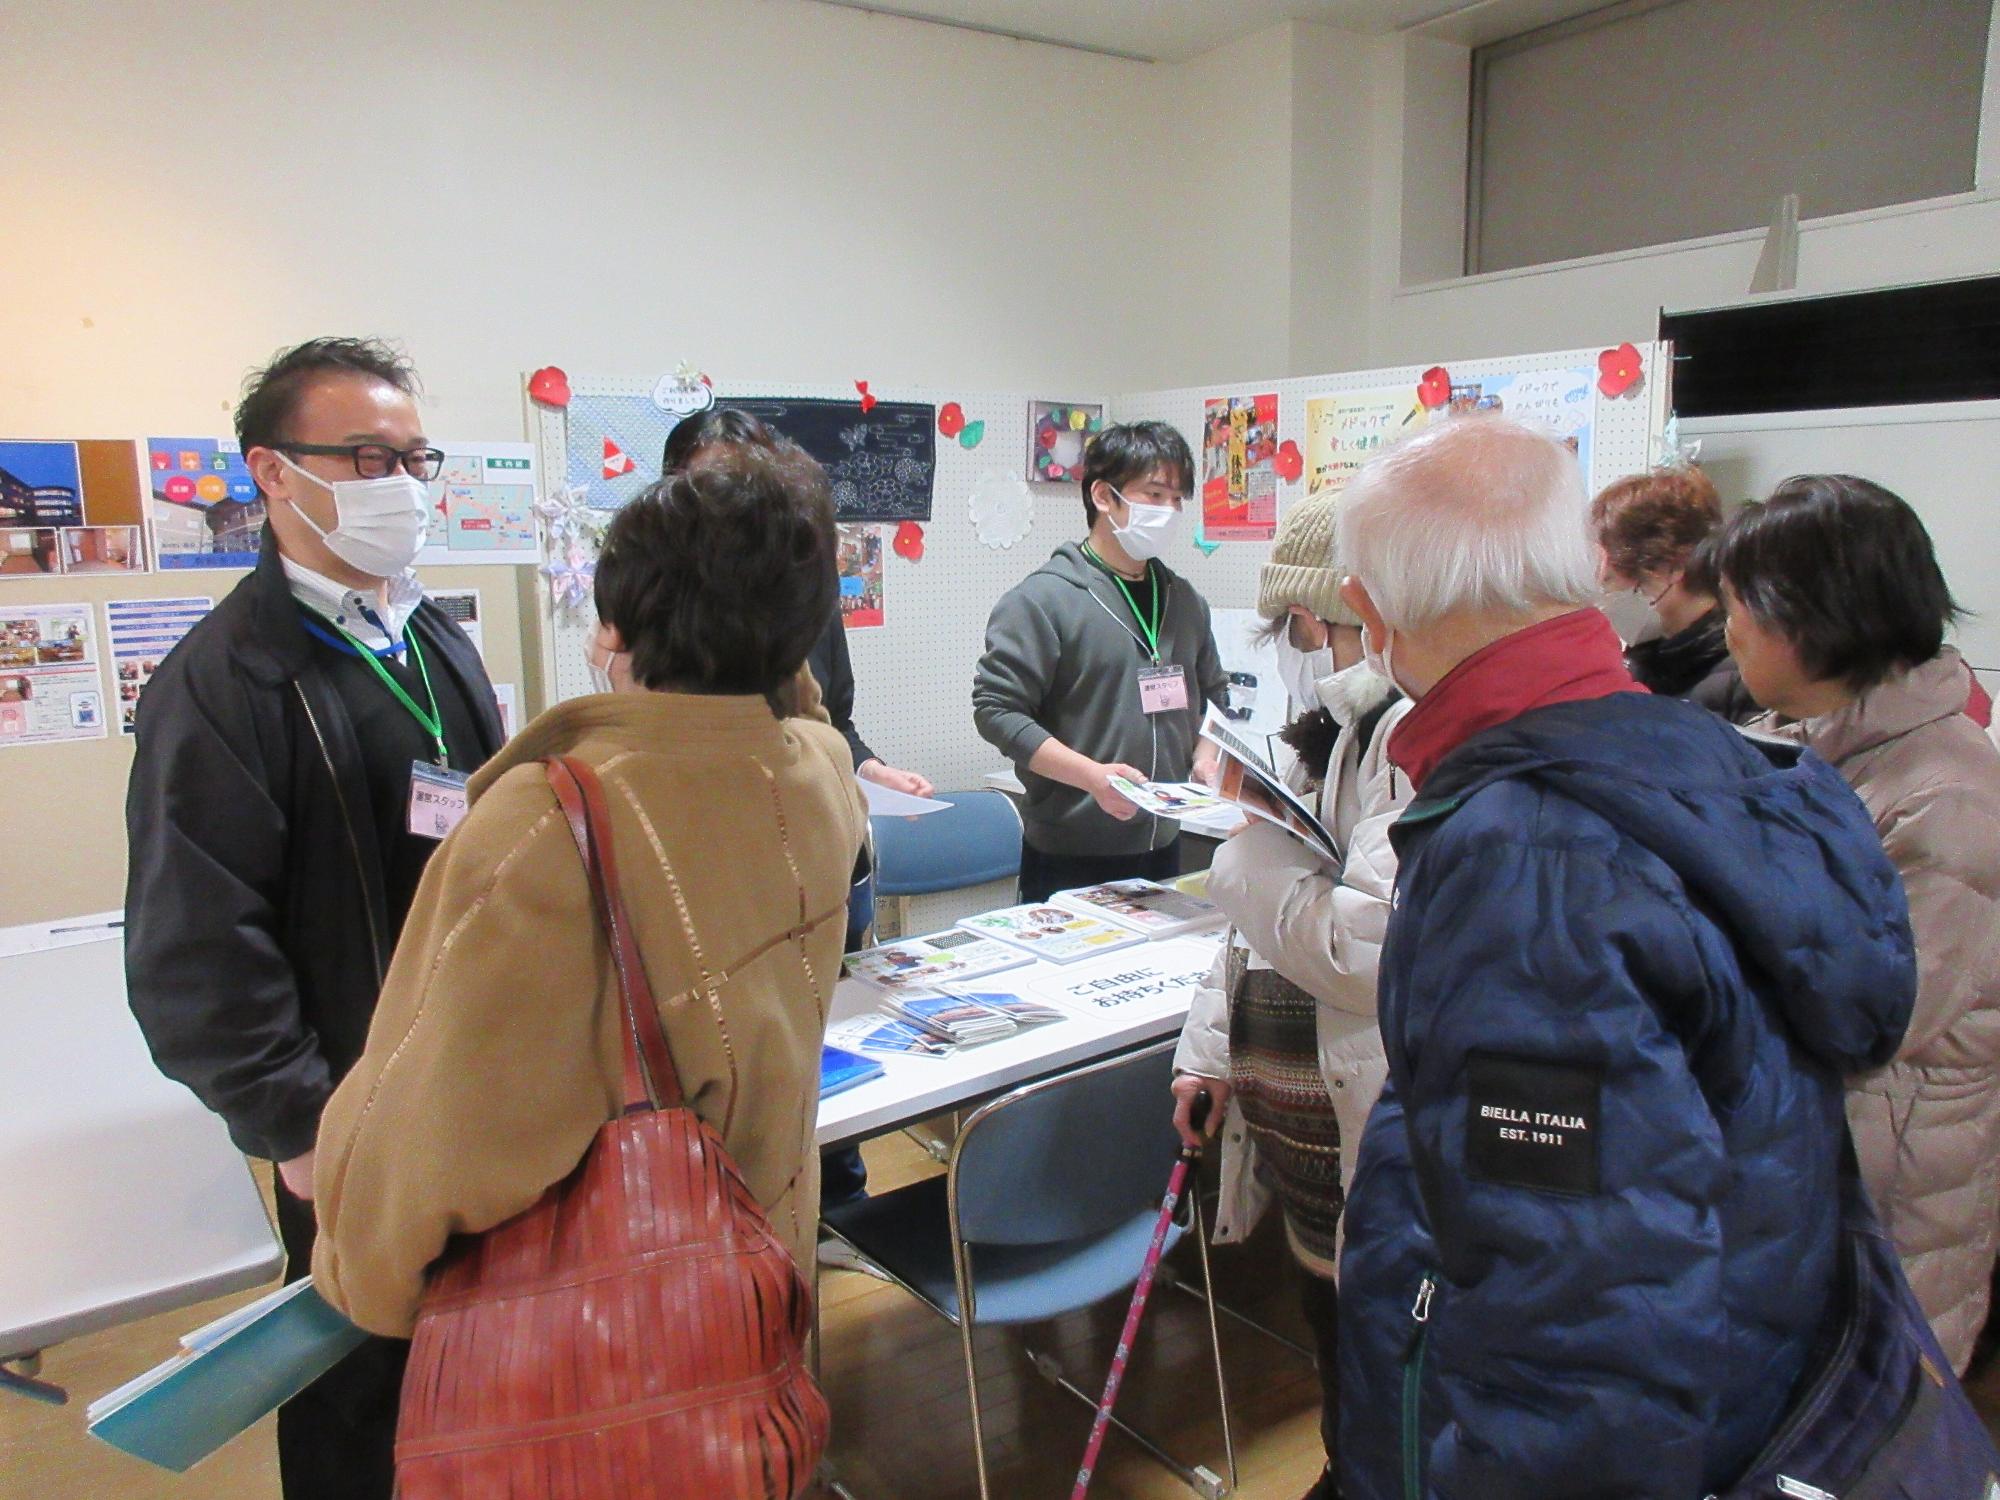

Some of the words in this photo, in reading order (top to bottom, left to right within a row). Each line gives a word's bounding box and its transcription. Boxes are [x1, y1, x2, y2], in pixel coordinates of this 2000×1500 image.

[1066, 967, 1165, 996] ご自由に
[1092, 969, 1211, 1008] お持ちくださ
[1480, 1105, 1531, 1124] BIELLA
[1535, 1112, 1588, 1130] ITALIA
[1499, 1127, 1529, 1142] EST.
[1532, 1131, 1563, 1146] 1911
